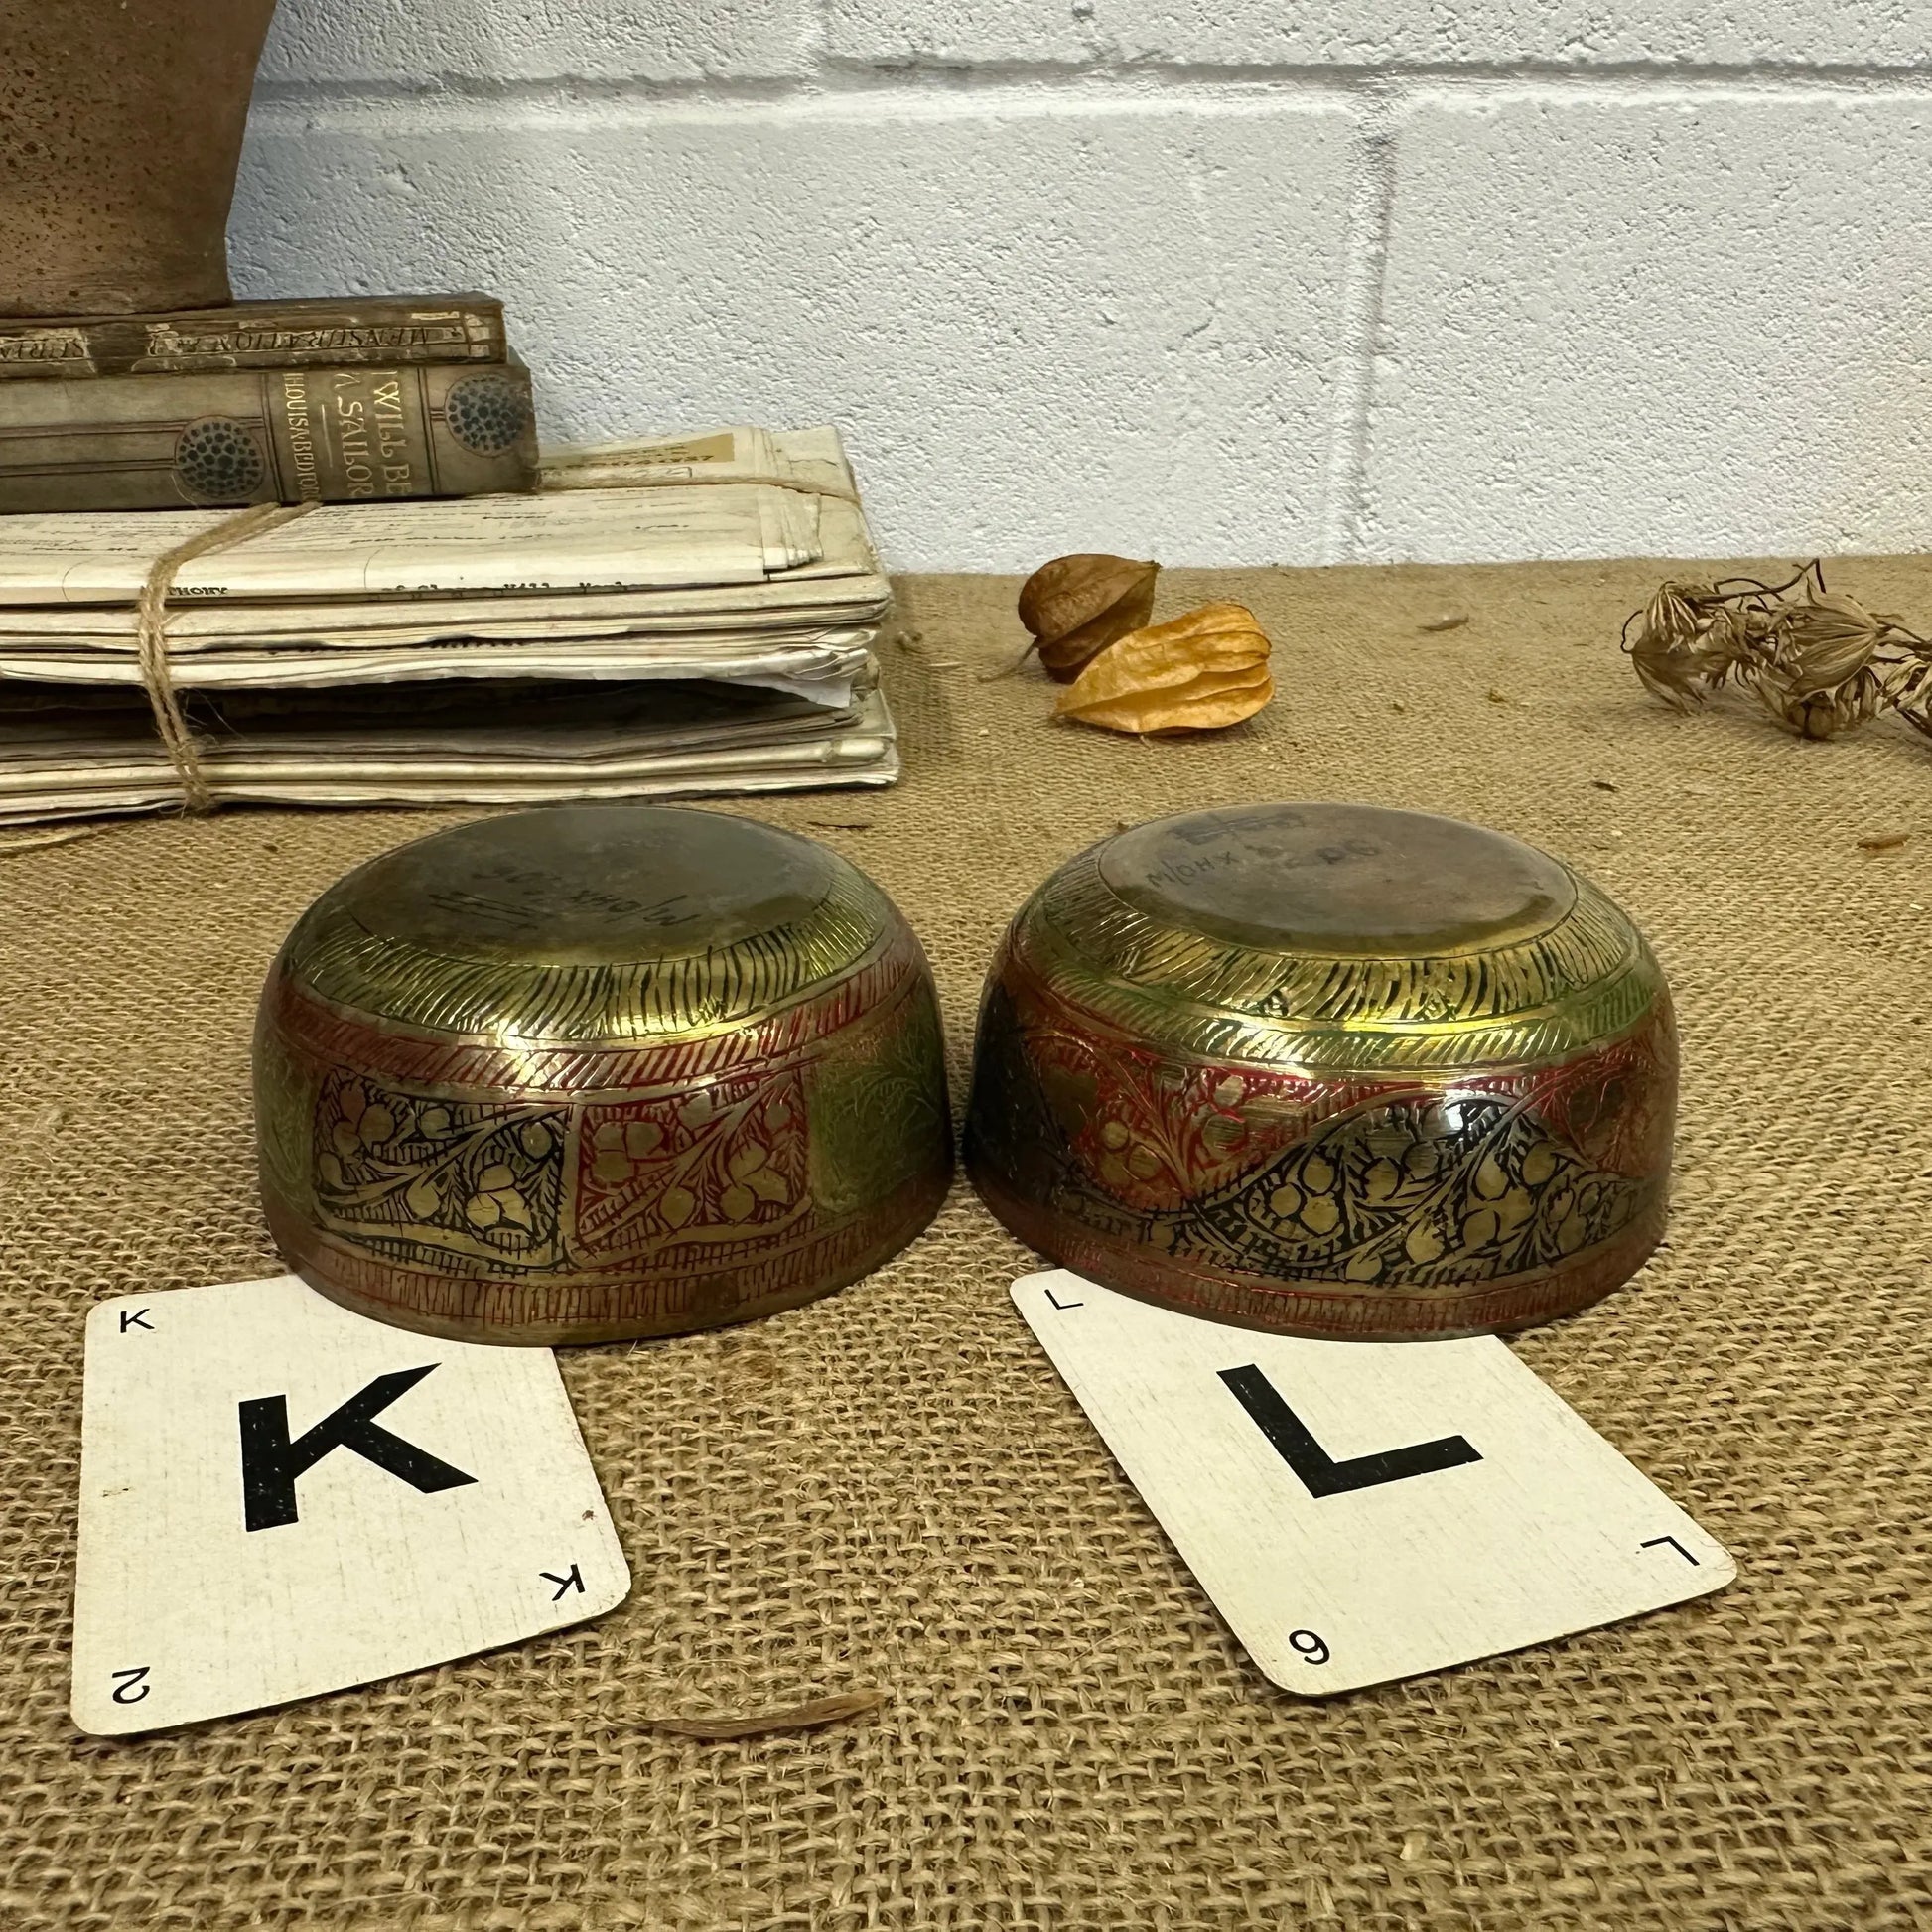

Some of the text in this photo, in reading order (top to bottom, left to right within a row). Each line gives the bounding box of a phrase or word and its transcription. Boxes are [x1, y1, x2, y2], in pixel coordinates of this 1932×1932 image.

[373, 381, 407, 458] WILL
[337, 396, 375, 498] SAILOR
[383, 463, 414, 495] BE
[1043, 1288, 1085, 1311] L
[119, 1309, 155, 1334] K
[238, 1361, 480, 1533] K
[1215, 1362, 1485, 1500] L
[1639, 1535, 1701, 1567] L
[538, 1564, 586, 1602] K
[111, 1666, 151, 1705] 2
